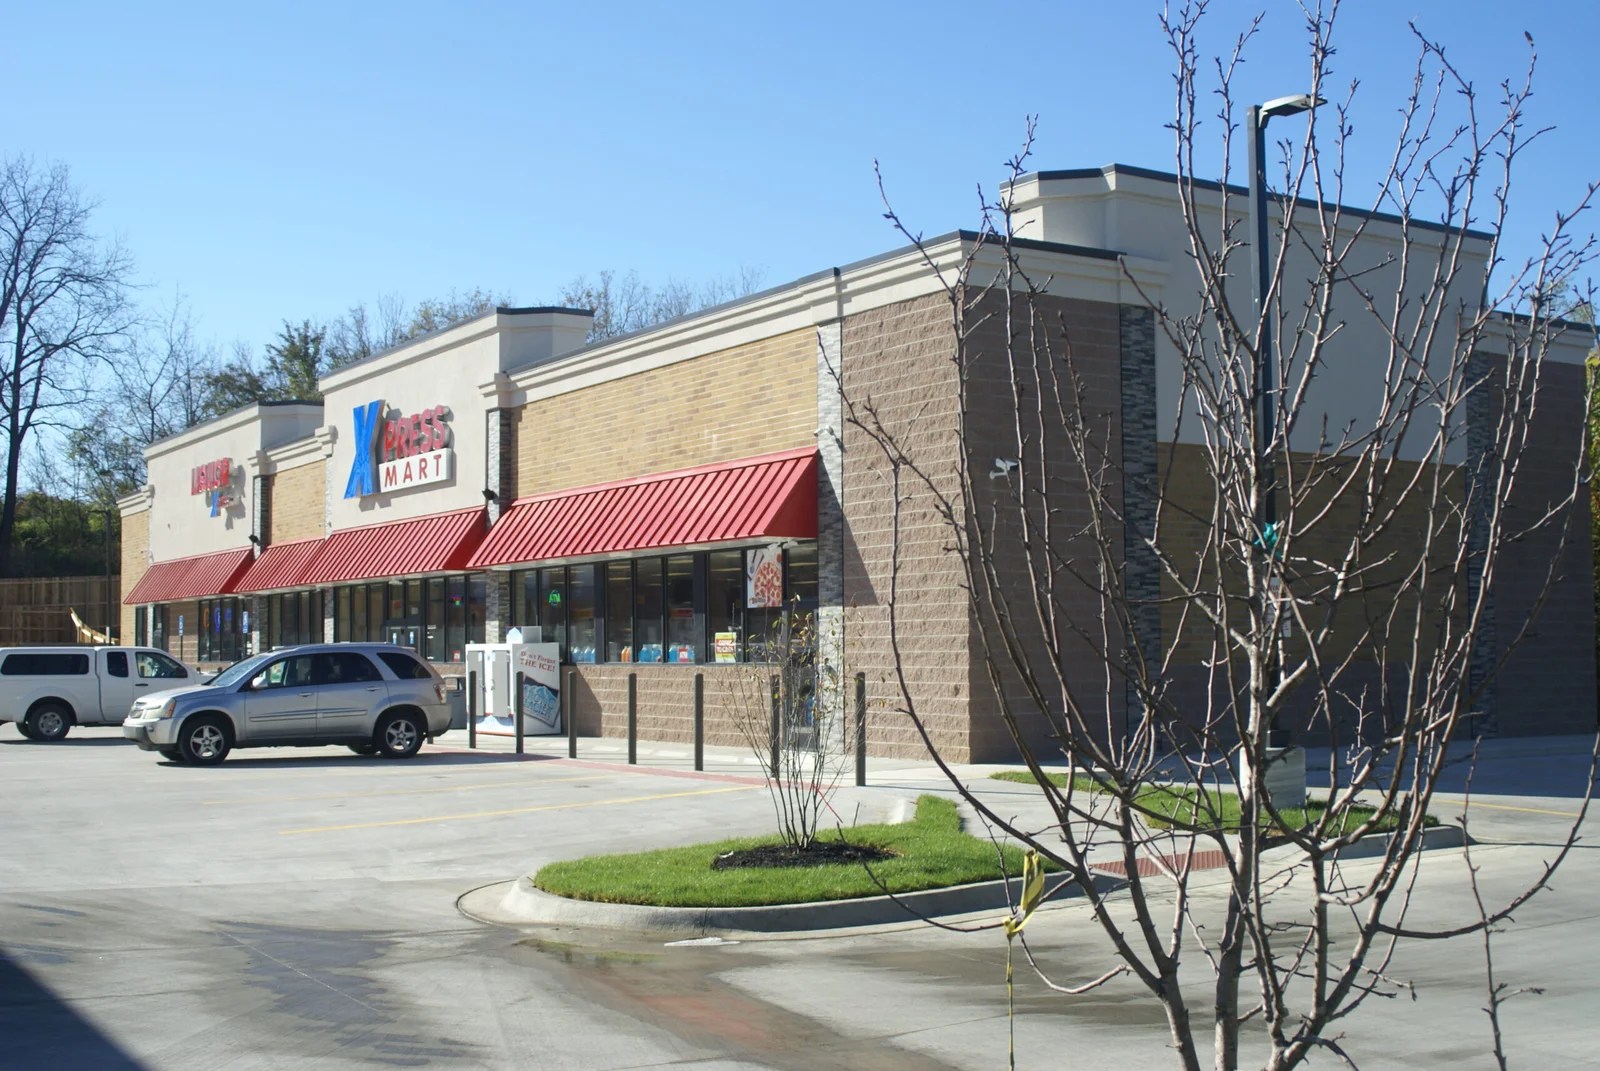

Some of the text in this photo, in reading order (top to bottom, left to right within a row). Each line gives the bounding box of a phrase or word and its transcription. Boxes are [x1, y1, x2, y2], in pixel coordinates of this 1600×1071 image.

[385, 454, 442, 487] MART
[520, 658, 556, 672] THE ICE!
